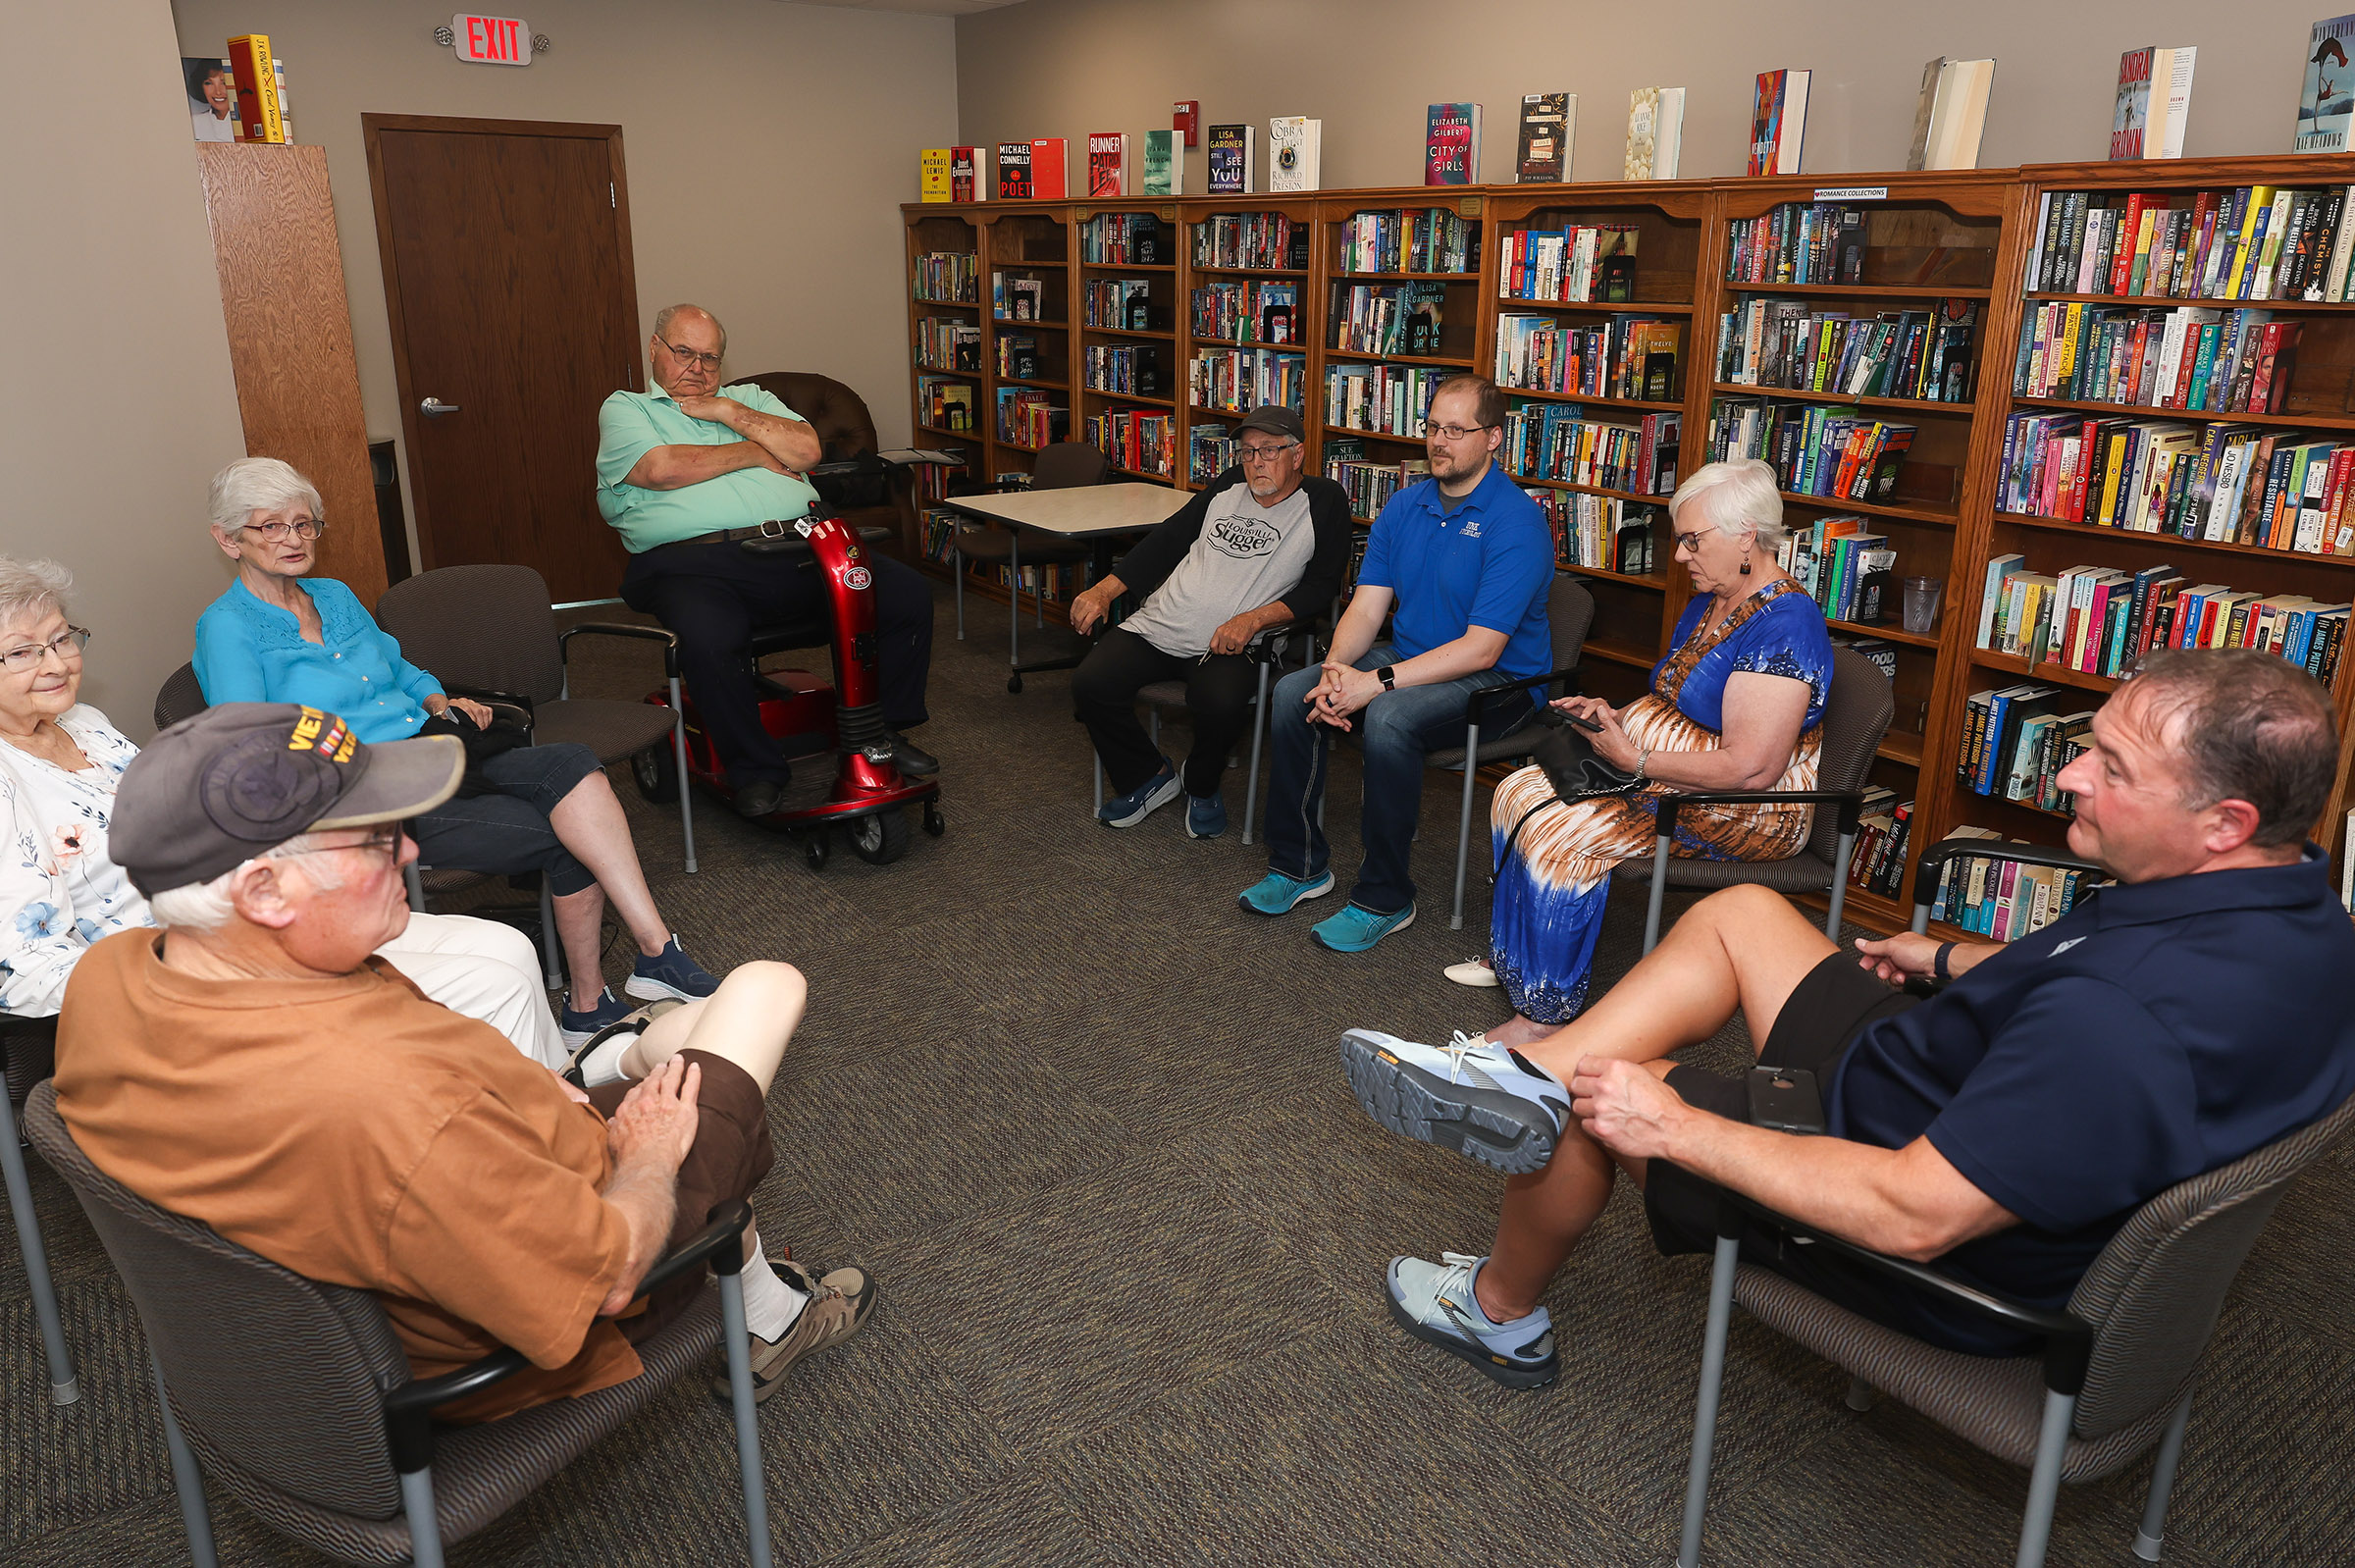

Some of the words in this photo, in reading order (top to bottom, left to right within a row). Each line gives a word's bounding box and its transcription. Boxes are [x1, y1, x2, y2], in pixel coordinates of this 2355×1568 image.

[466, 17, 519, 61] EXIT
[259, 50, 270, 76] ROWLING
[2120, 50, 2149, 84] SANDRA
[1271, 119, 1304, 140] COBRA
[1432, 117, 1468, 126] ELIZABETH
[1090, 137, 1120, 153] RUNNER
[1219, 131, 1234, 139] LISA
[2111, 128, 2142, 159] BROWN
[999, 145, 1031, 154] MICHAEL
[1430, 146, 1455, 157] CITY
[1752, 140, 1775, 155] VENDETTA
[1000, 155, 1030, 165] CONNELLY
[1227, 157, 1242, 166] SEE
[1433, 161, 1464, 172] GIRLS
[1212, 168, 1240, 182] YOU
[1273, 171, 1302, 181] RICHARD
[1001, 182, 1031, 196] POET
[1273, 181, 1302, 191] PRESTON
[2052, 212, 2062, 225] NOT
[2127, 202, 2136, 226] MURDER
[2217, 197, 2227, 229] MEDDON
[2294, 208, 2305, 225] BRAD
[2303, 203, 2316, 232] MELTZER
[2311, 208, 2320, 227] BRAD
[2330, 198, 2340, 227] STEPHENIE
[2047, 226, 2059, 252] DISTURB
[2060, 220, 2071, 247] DAMAGE
[2166, 228, 2175, 241] KAT
[2286, 227, 2300, 254] MELTZER
[2340, 229, 2350, 253] PATIENT
[1754, 244, 1763, 257] DUEL
[2161, 242, 2172, 270] MARTIN
[2312, 229, 2329, 277] CHEMIST
[1753, 263, 1761, 279] DEATH
[2277, 264, 2287, 282] ARTIST
[2282, 268, 2292, 287] ESCAPE
[2293, 271, 2302, 285] EVEN
[1780, 308, 1802, 318] THEN
[2176, 312, 2186, 332] Three
[1753, 316, 1761, 345] EVASIONS
[2065, 314, 2075, 342] PATRIOT
[2089, 325, 2098, 350] MIRANDA
[2230, 314, 2241, 341] MARIA
[2053, 340, 2063, 364] LEATHER
[2172, 334, 2182, 357] Wishes
[2195, 341, 2206, 366] MONROE
[2061, 343, 2070, 371] ATTACK
[2200, 355, 2210, 369] ALICE
[1550, 405, 1582, 417] CAROL
[1782, 432, 1794, 450] STEPHEN
[2035, 430, 2046, 462] INVITATION
[2095, 432, 2104, 454] PRIME
[2200, 429, 2216, 451] CARLA
[1330, 453, 1363, 462] GRAFTON
[1780, 451, 1790, 463] KING
[2226, 450, 2236, 461] JO
[2282, 454, 2291, 477] CELESTE
[1805, 455, 1815, 480] TWISTED
[2196, 453, 2210, 485] NEGGERS
[1857, 478, 1869, 499] MOTIVE
[2280, 479, 2287, 488] NG
[2262, 478, 2278, 523] RESISTANCE
[2330, 496, 2342, 516] LAURIE
[1210, 523, 1272, 551] Slugger
[2327, 518, 2338, 541] NOTARO
[2136, 580, 2145, 601] STEWART
[2233, 618, 2243, 630] SARA
[2331, 621, 2342, 641] James
[2289, 630, 2299, 654] MAGNIFICENT
[2298, 637, 2308, 660] PATTERSON
[2313, 629, 2327, 651] JAMES
[2326, 642, 2337, 670] Patterson
[1990, 699, 2000, 715] JAMES
[1965, 709, 1975, 730] JAMES
[1976, 714, 1986, 732] JAMES
[1985, 715, 1997, 742] PATTERSON
[1960, 731, 1972, 766] PATTERSON
[1971, 733, 1983, 764] PATTERSON
[1982, 752, 1991, 770] PICASSO
[1978, 771, 1987, 786] HEIST
[1988, 871, 1998, 897] PICOULT
[2052, 890, 2061, 907] PLAIN
[2061, 895, 2071, 913] PLAIN
[2034, 904, 2045, 918] PLAIN
